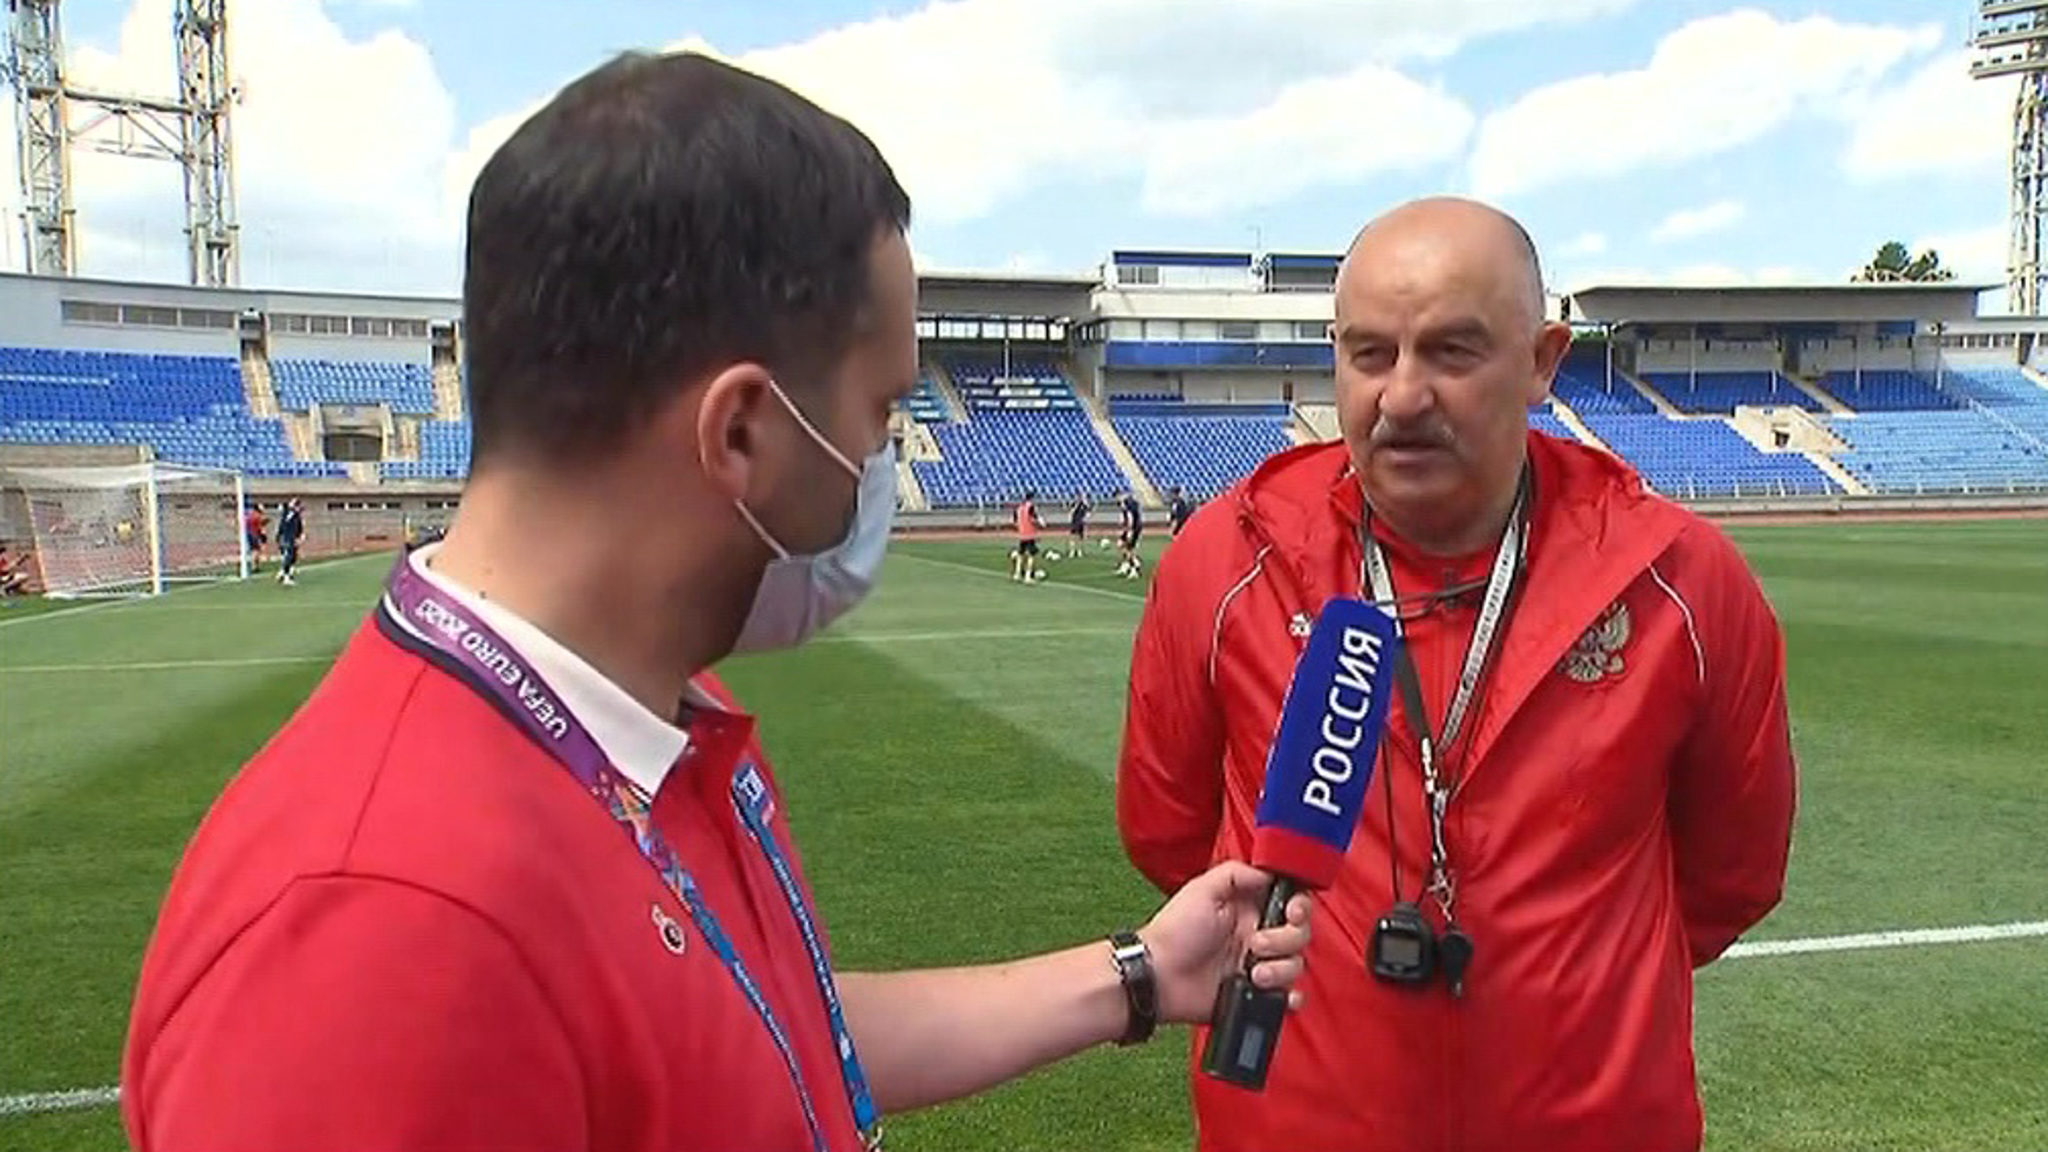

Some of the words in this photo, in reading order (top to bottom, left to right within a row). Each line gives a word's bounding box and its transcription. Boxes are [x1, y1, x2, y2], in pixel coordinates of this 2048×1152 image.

[461, 631, 522, 686] EURO
[517, 678, 568, 739] UEFA
[1302, 626, 1383, 816] РОССИЯ
